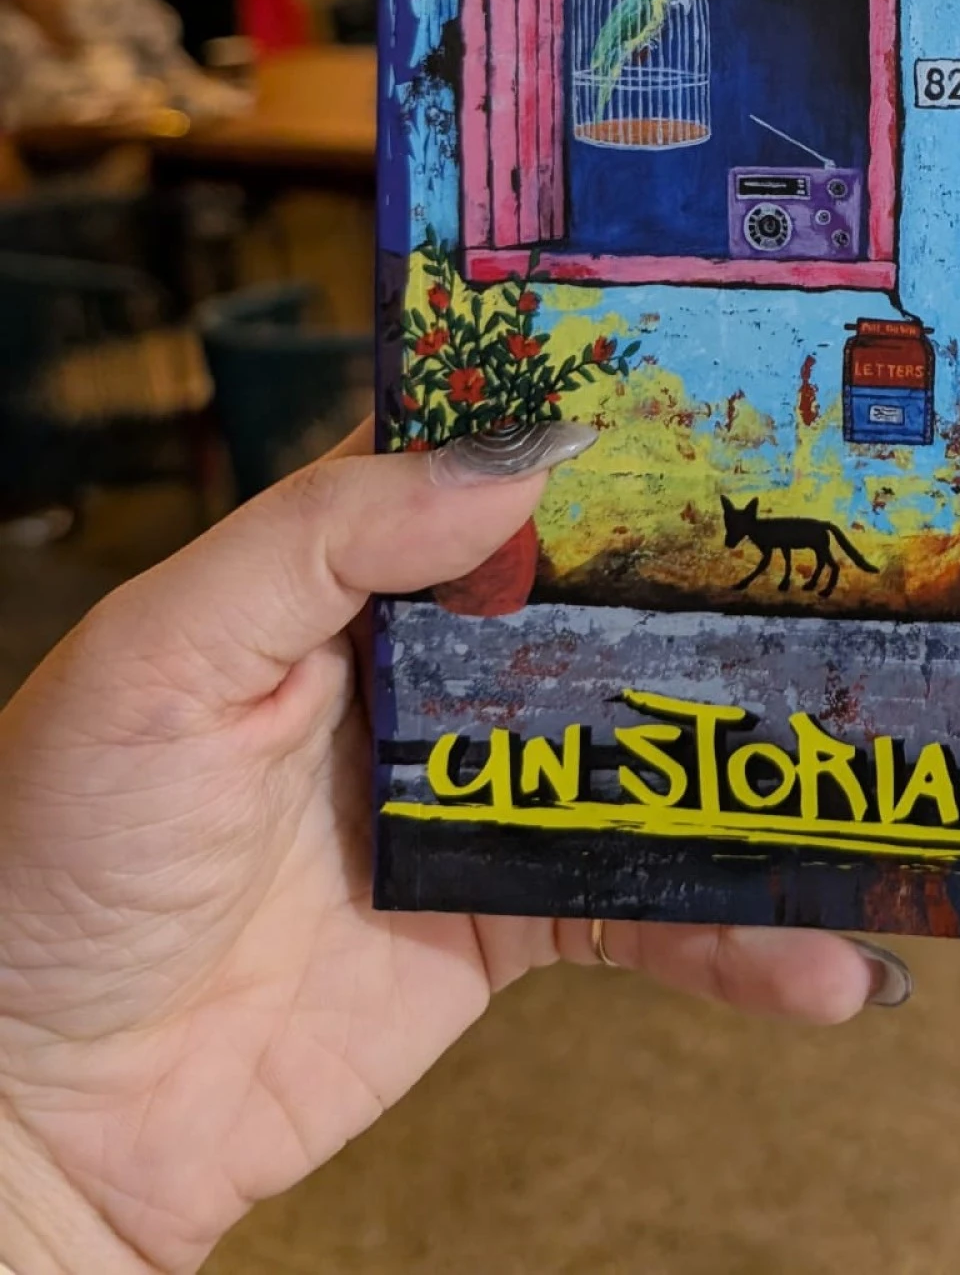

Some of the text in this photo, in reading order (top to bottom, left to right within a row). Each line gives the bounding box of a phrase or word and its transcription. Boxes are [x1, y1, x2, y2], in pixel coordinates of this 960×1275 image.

[854, 362, 924, 378] LETTERS
[428, 724, 581, 812] UN
[614, 689, 959, 825] STORIA
